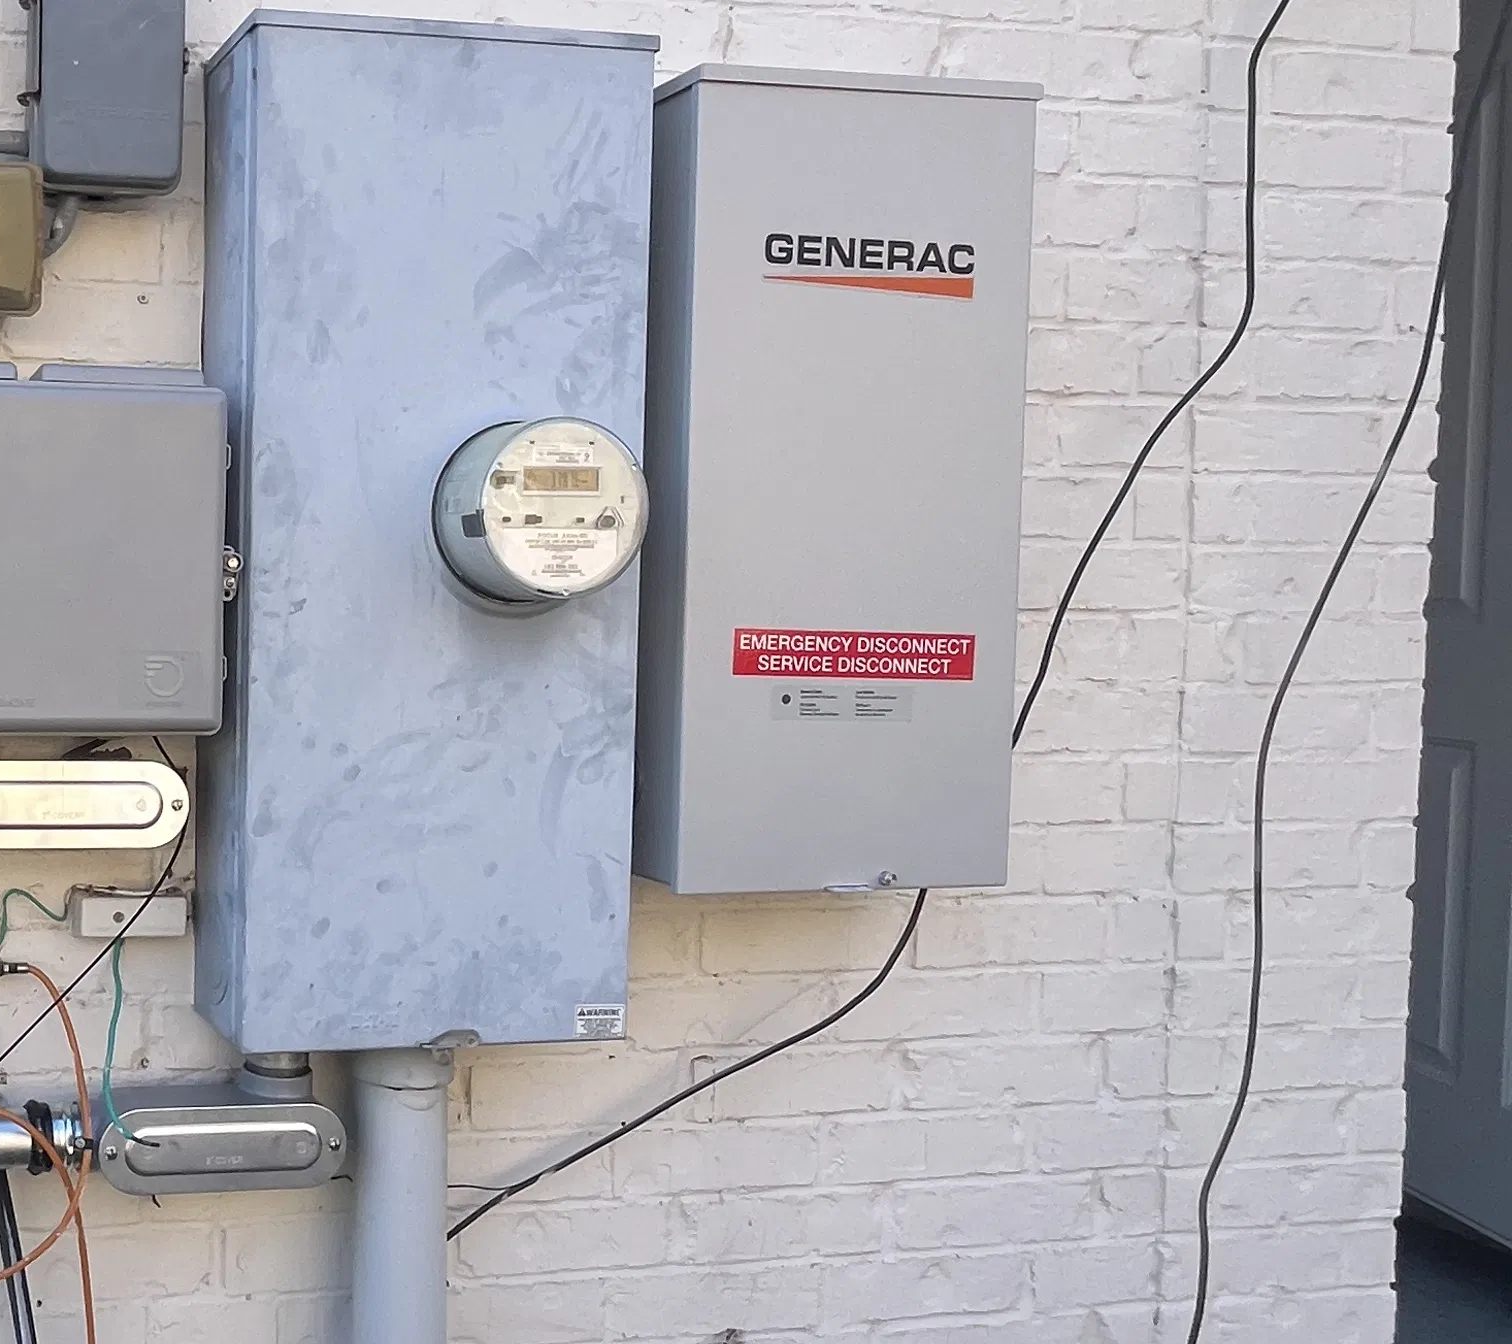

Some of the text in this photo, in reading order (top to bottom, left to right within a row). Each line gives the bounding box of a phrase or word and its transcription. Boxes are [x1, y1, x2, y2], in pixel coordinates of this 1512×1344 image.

[764, 232, 977, 275] GENERAC
[739, 634, 971, 656] EMERGENCY DISCONNECT
[757, 655, 952, 675] SERVICE DISCONNECT
